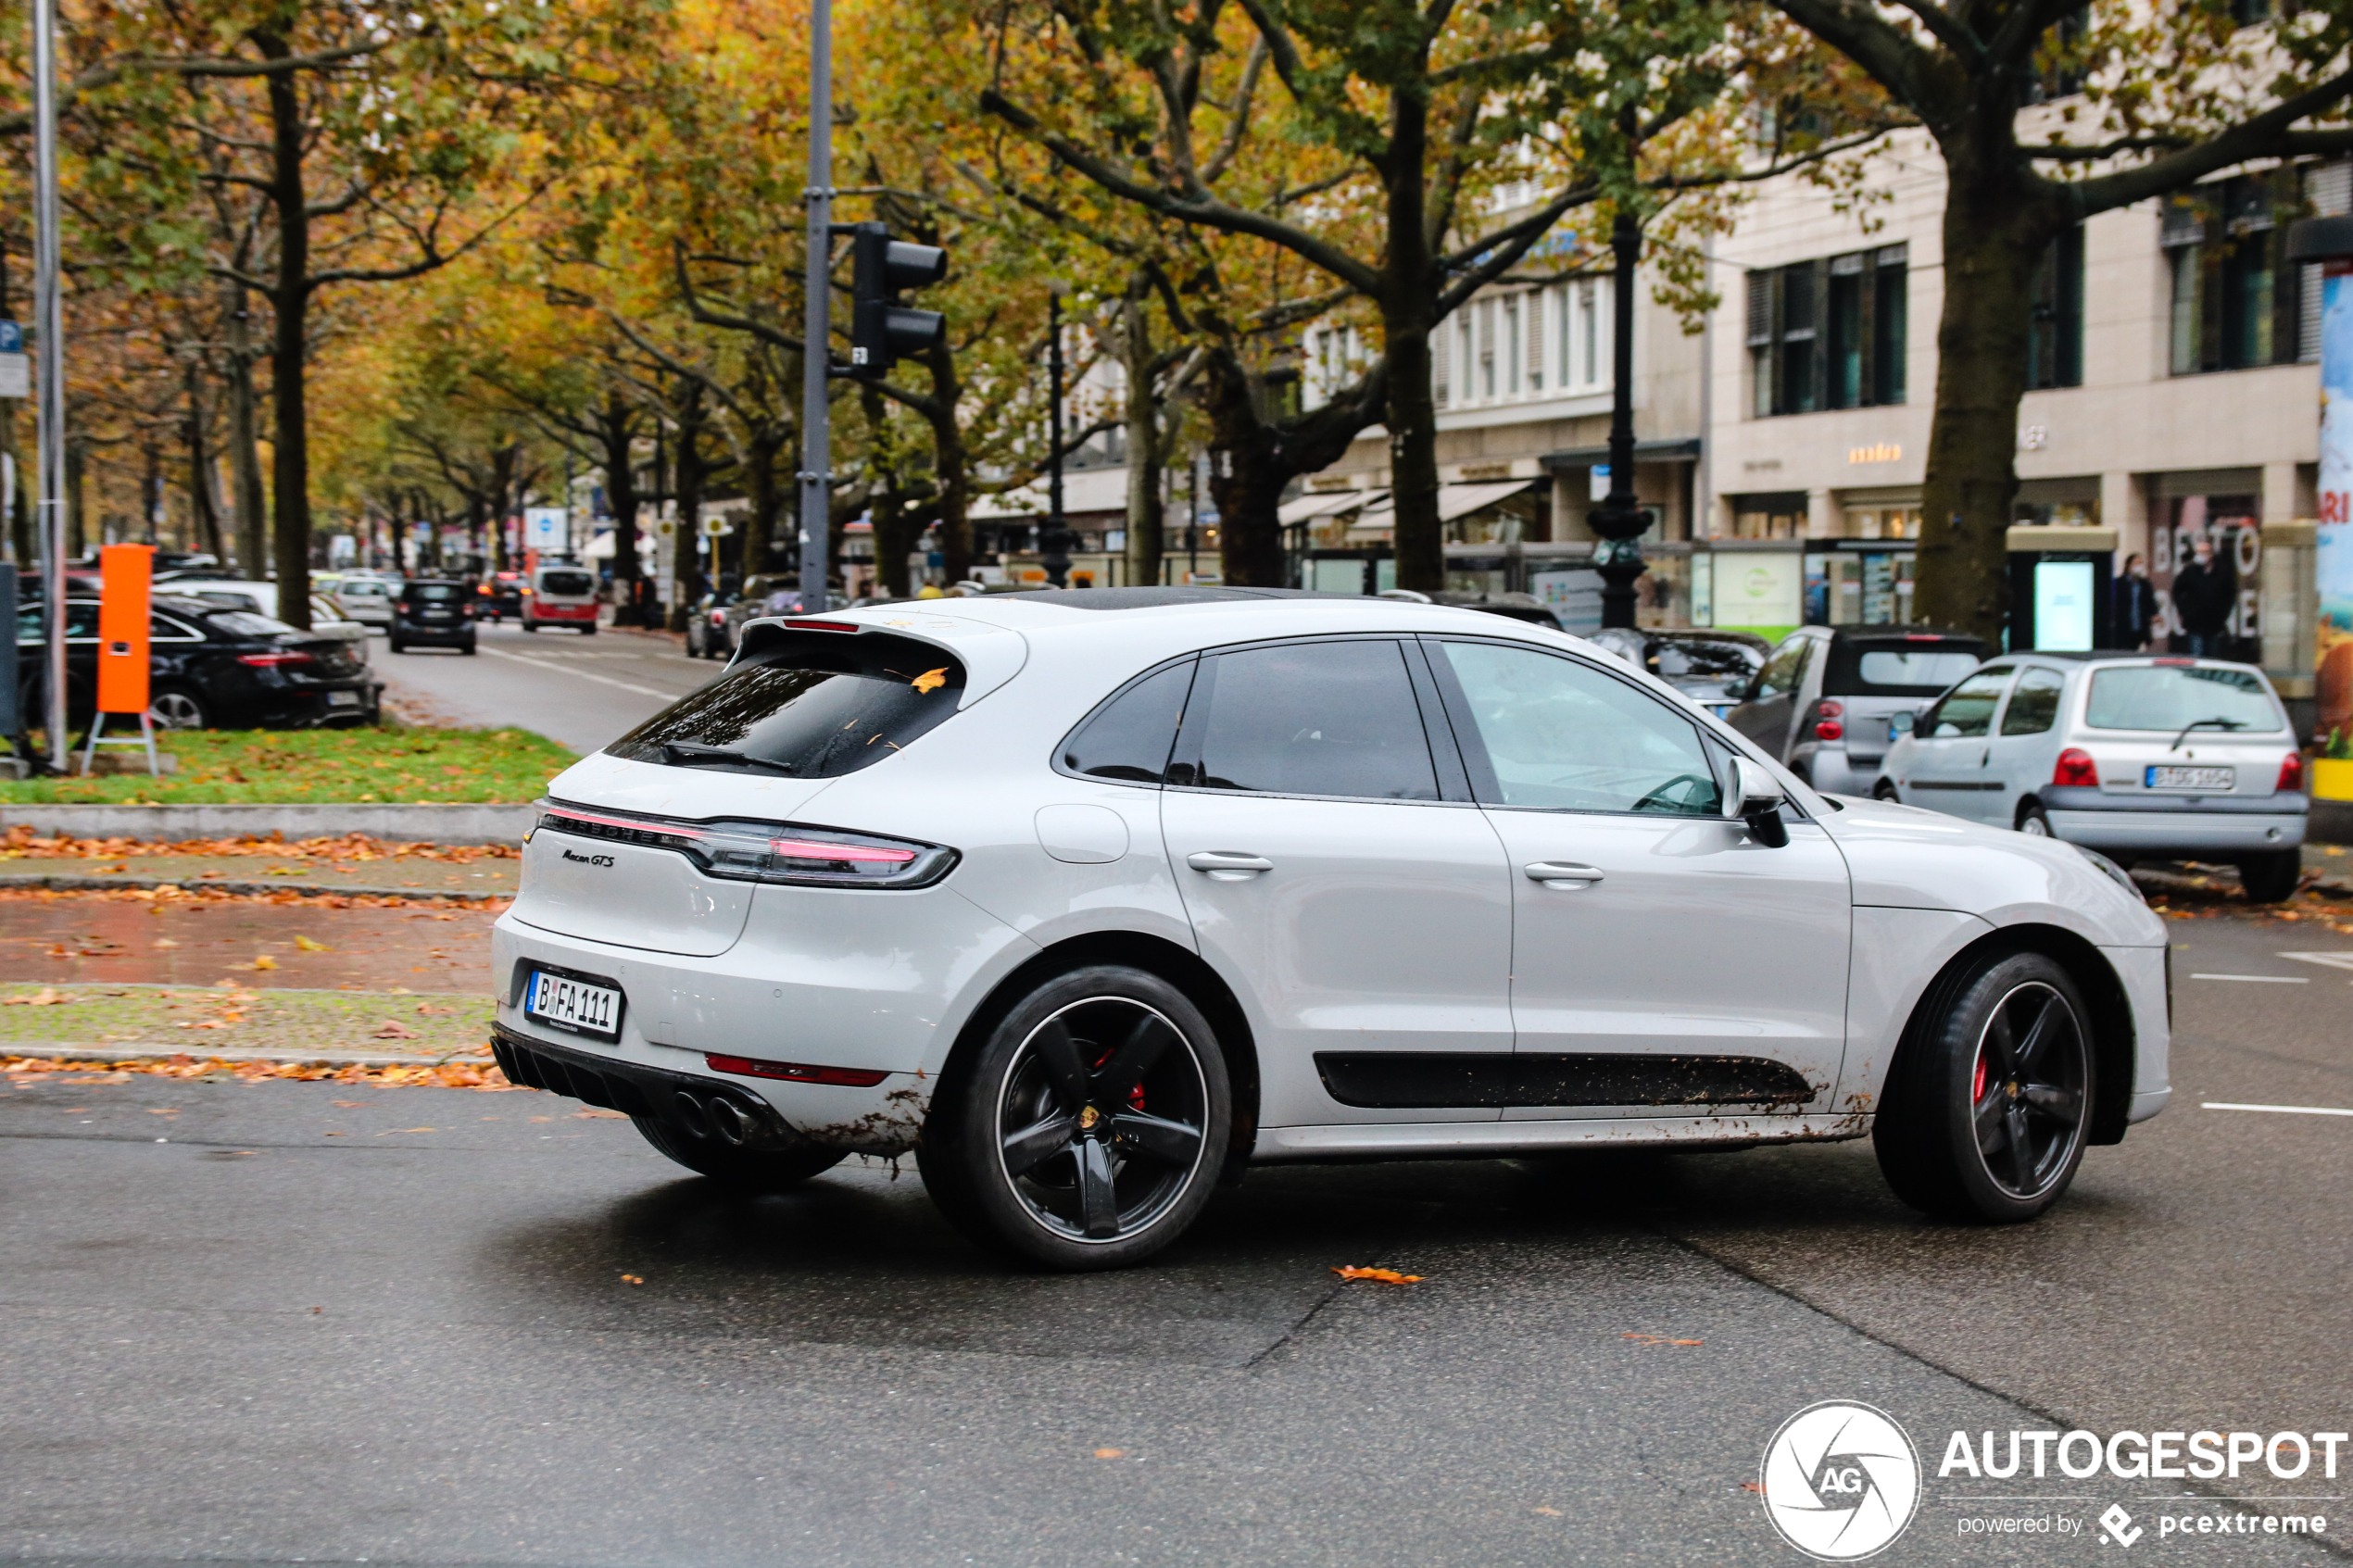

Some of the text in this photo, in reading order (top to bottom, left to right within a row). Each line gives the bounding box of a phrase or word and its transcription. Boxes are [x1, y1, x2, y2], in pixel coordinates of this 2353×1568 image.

[554, 817, 655, 842] PORSCHE
[562, 848, 615, 868] Macan GTS
[538, 977, 550, 1011] B
